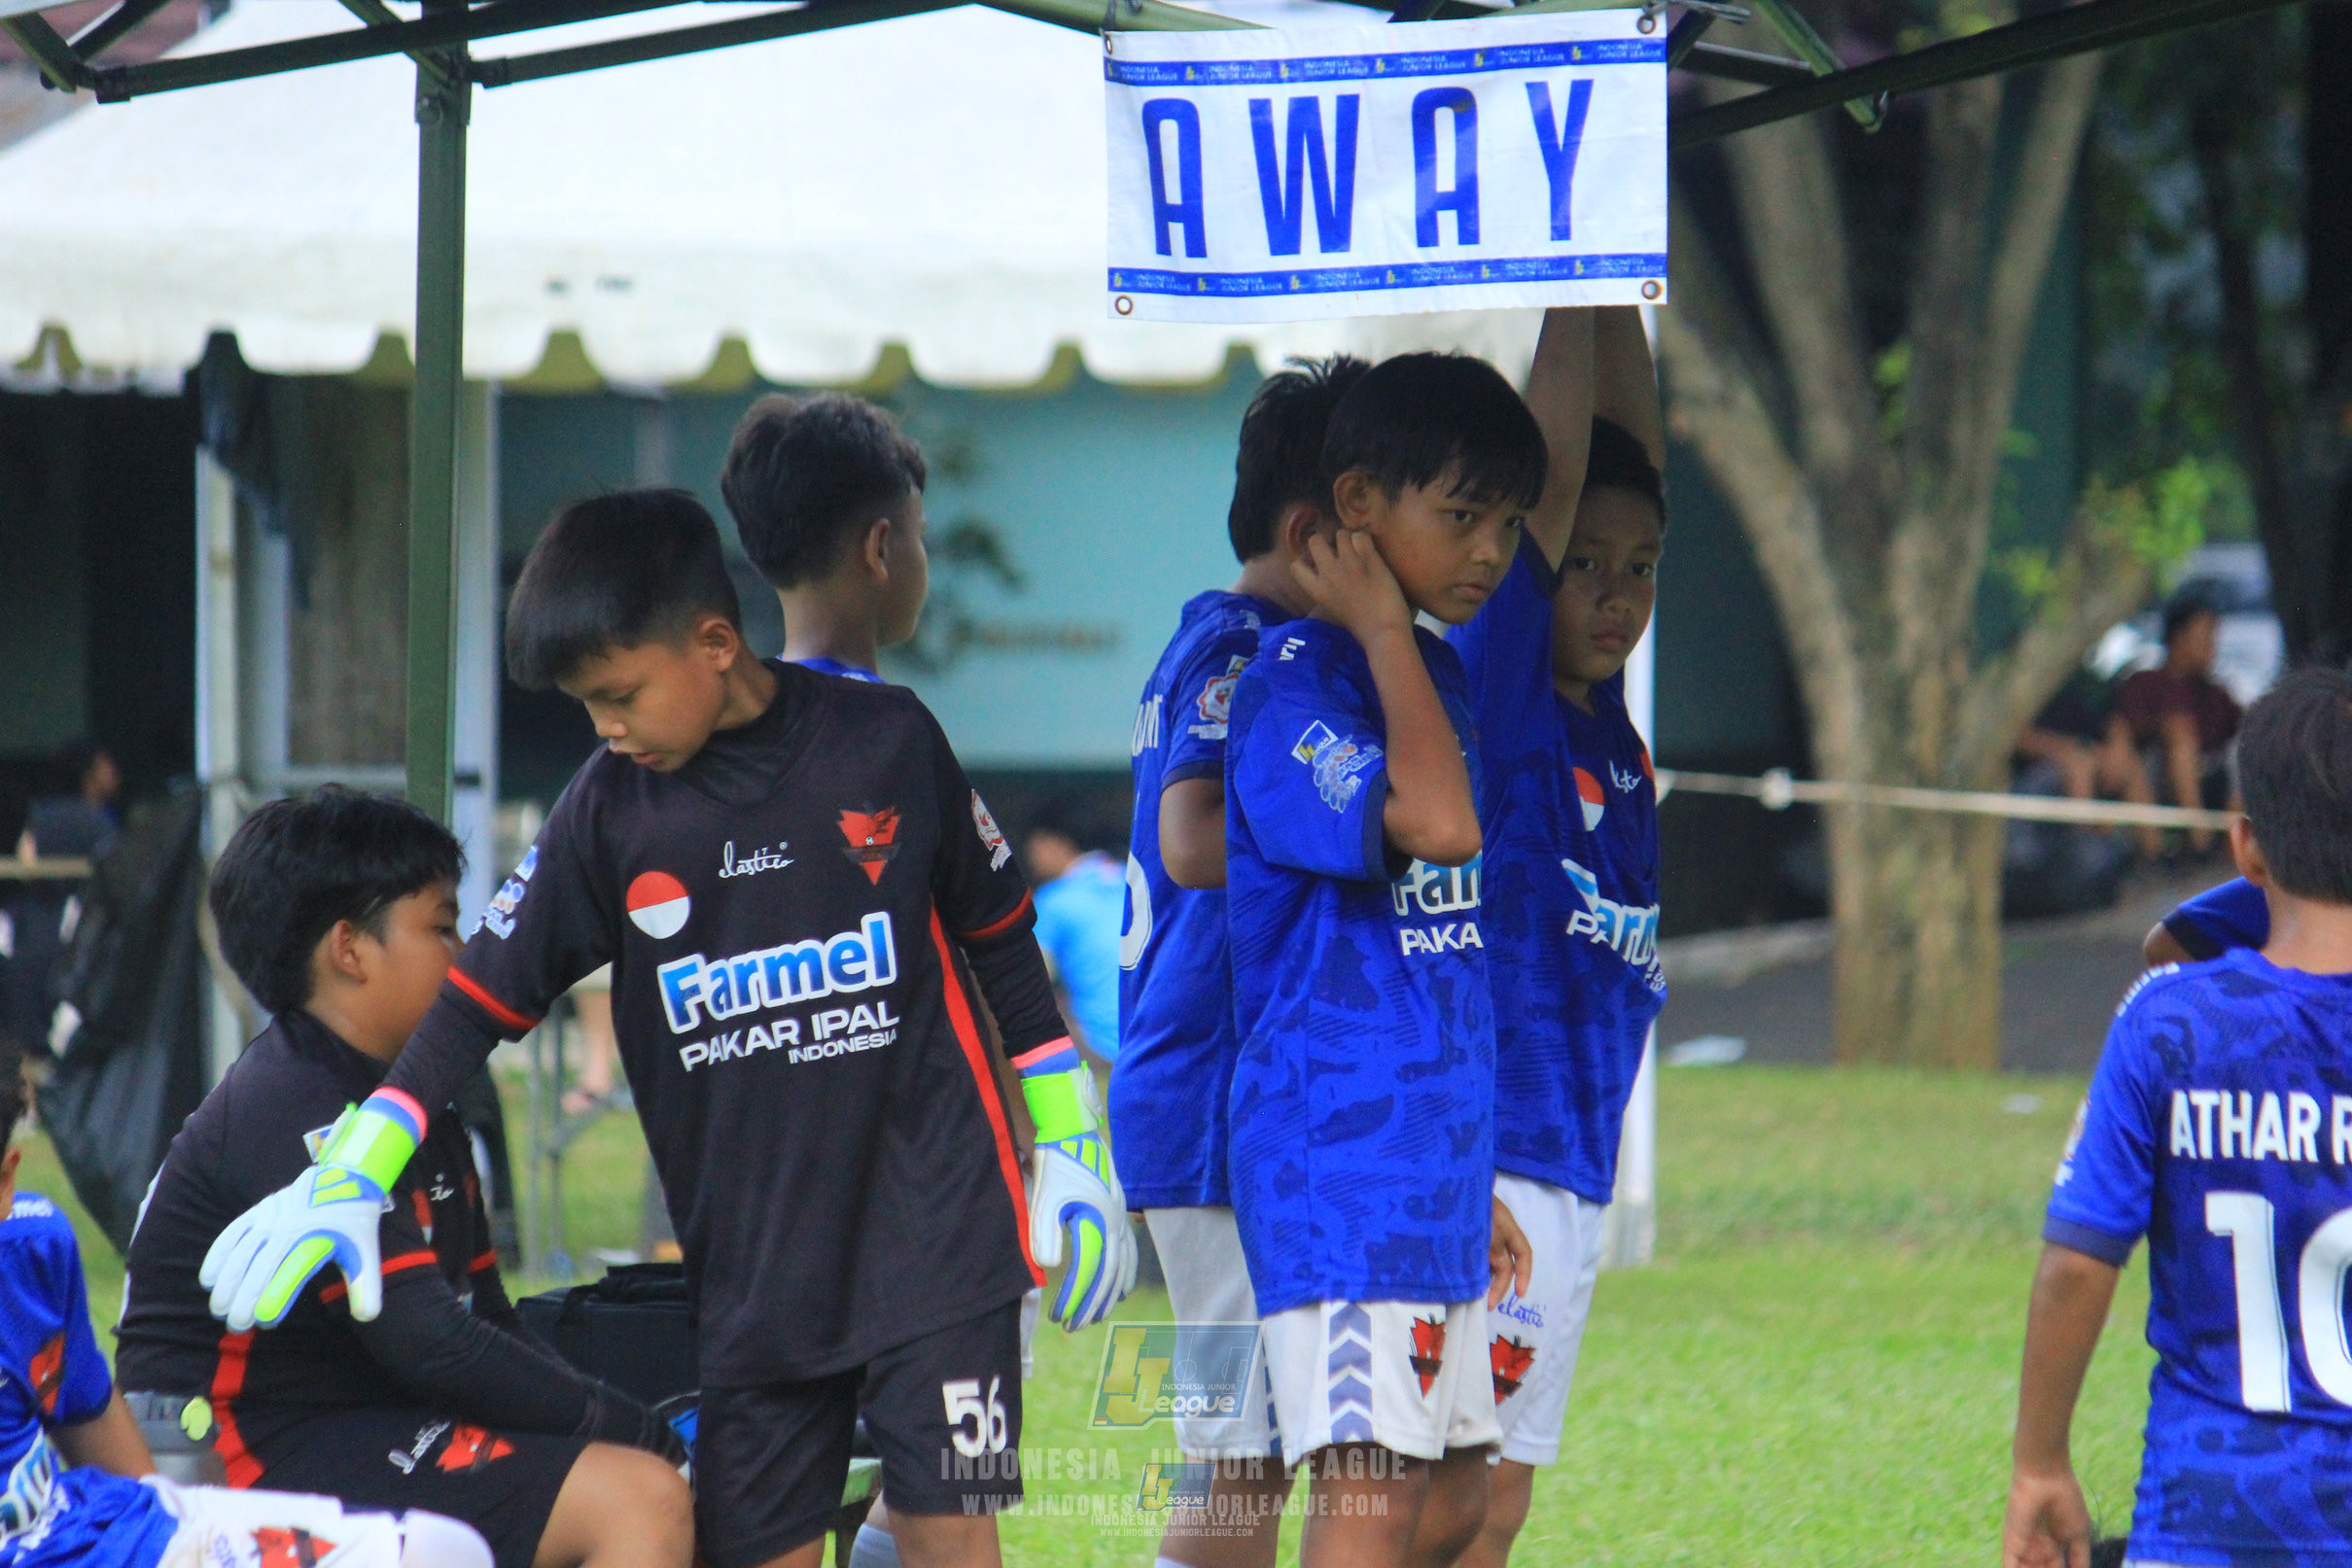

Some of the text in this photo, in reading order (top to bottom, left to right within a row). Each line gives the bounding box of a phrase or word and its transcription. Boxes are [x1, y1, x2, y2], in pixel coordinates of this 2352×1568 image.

[1141, 79, 1594, 258] AWAY
[657, 911, 897, 1034] Farmel
[679, 1001, 900, 1072] PAKAR IPAL
[788, 1028, 897, 1064] INDONESIA
[2170, 1089, 2320, 1163] ATHAR
[942, 1375, 1006, 1458] 56
